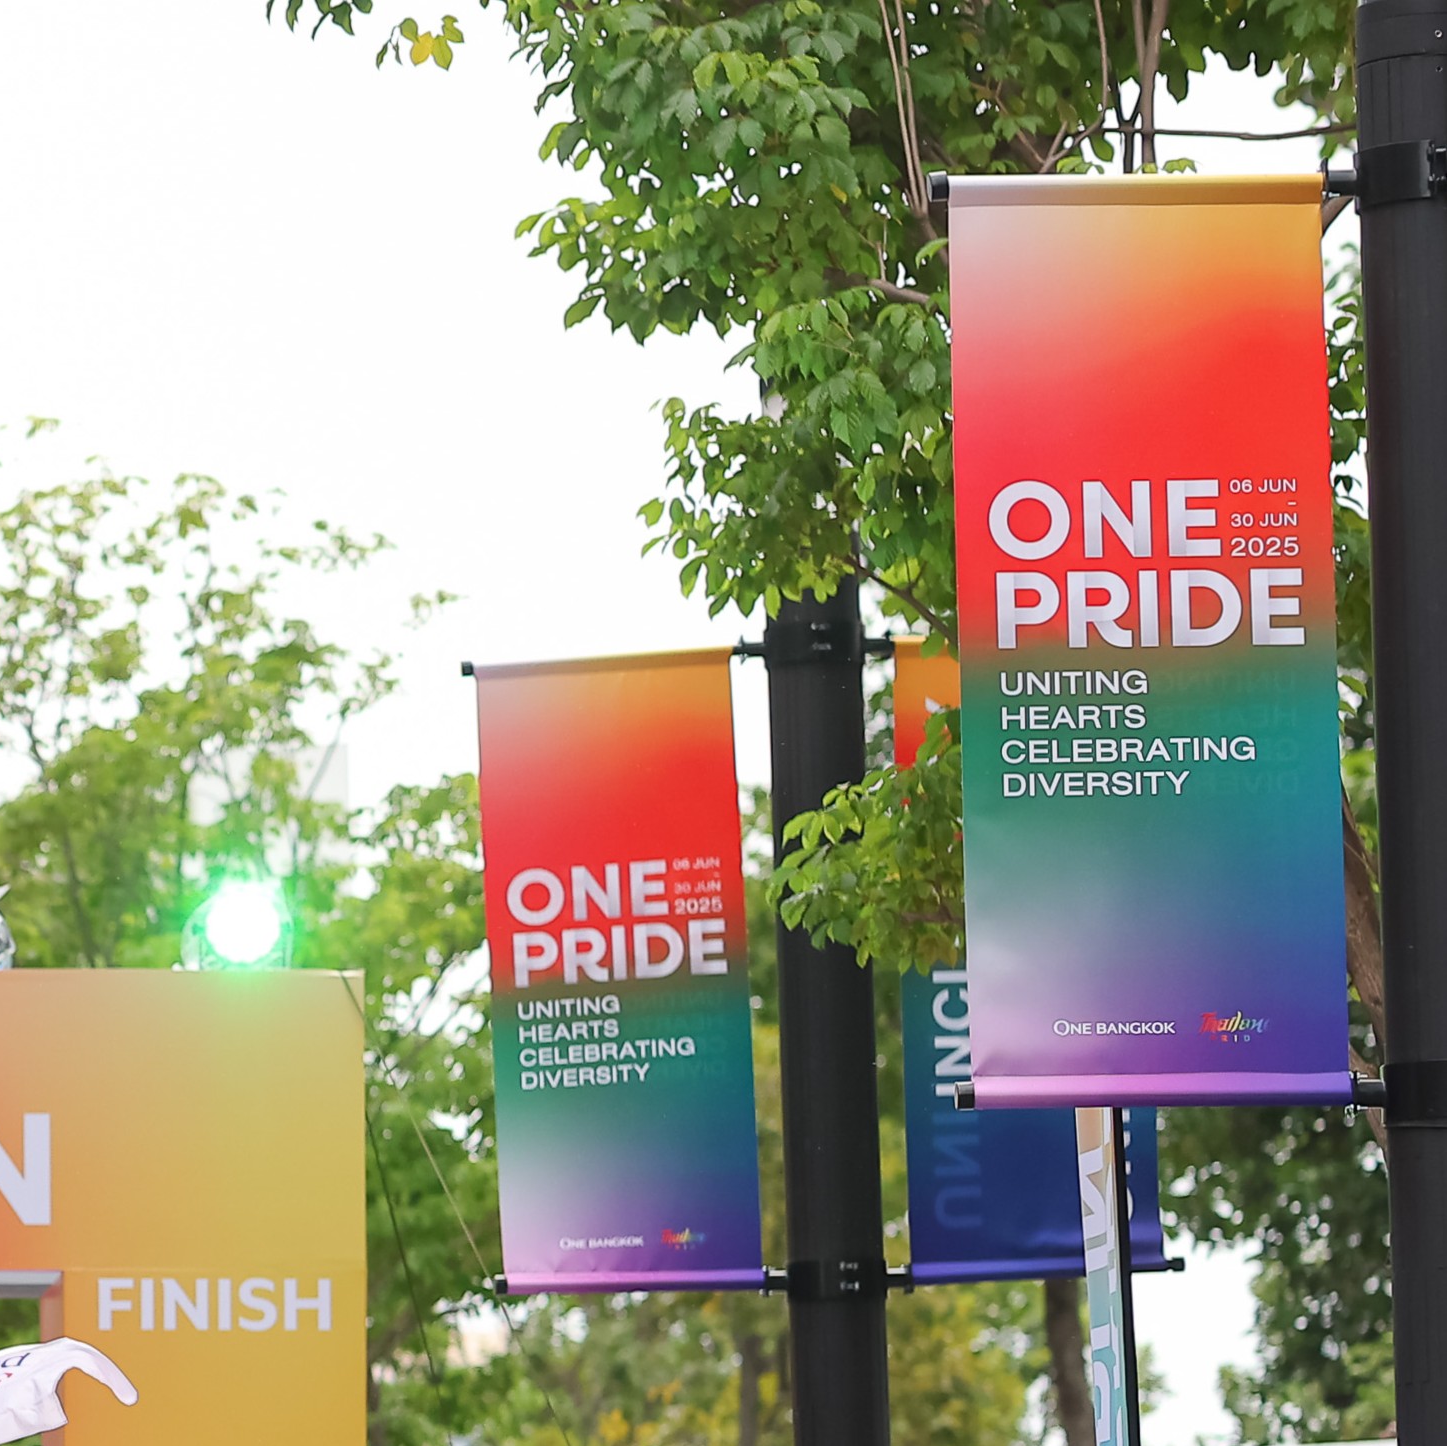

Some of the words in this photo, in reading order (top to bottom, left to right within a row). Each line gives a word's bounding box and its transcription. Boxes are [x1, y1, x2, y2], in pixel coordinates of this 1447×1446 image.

[1229, 479, 1252, 493] 06
[1258, 478, 1297, 493] JUN
[987, 478, 1223, 561] ONE
[1230, 513, 1253, 527] 30
[1259, 513, 1298, 527] JUN
[1230, 538, 1300, 558] 2025
[995, 567, 1306, 650] PRIDE
[999, 669, 1148, 697] UNITING
[1000, 704, 1146, 731] HEARTS
[1001, 736, 1256, 764] CELEBRATING
[1002, 770, 1190, 798] DIVERSITY
[692, 856, 720, 870] JUN
[506, 859, 669, 927] ONE
[694, 880, 721, 893] JUN
[512, 918, 728, 988] PRIDE
[517, 995, 621, 1021] UNITING
[518, 1019, 620, 1044] HEARTS
[1053, 1018, 1092, 1037] ONE
[1096, 1020, 1175, 1036] BANGKOK
[519, 1037, 696, 1067] CELEBRATING
[521, 1063, 650, 1090] DIVERSITY
[559, 1236, 586, 1249] ONE
[98, 1278, 332, 1332] FINISH
